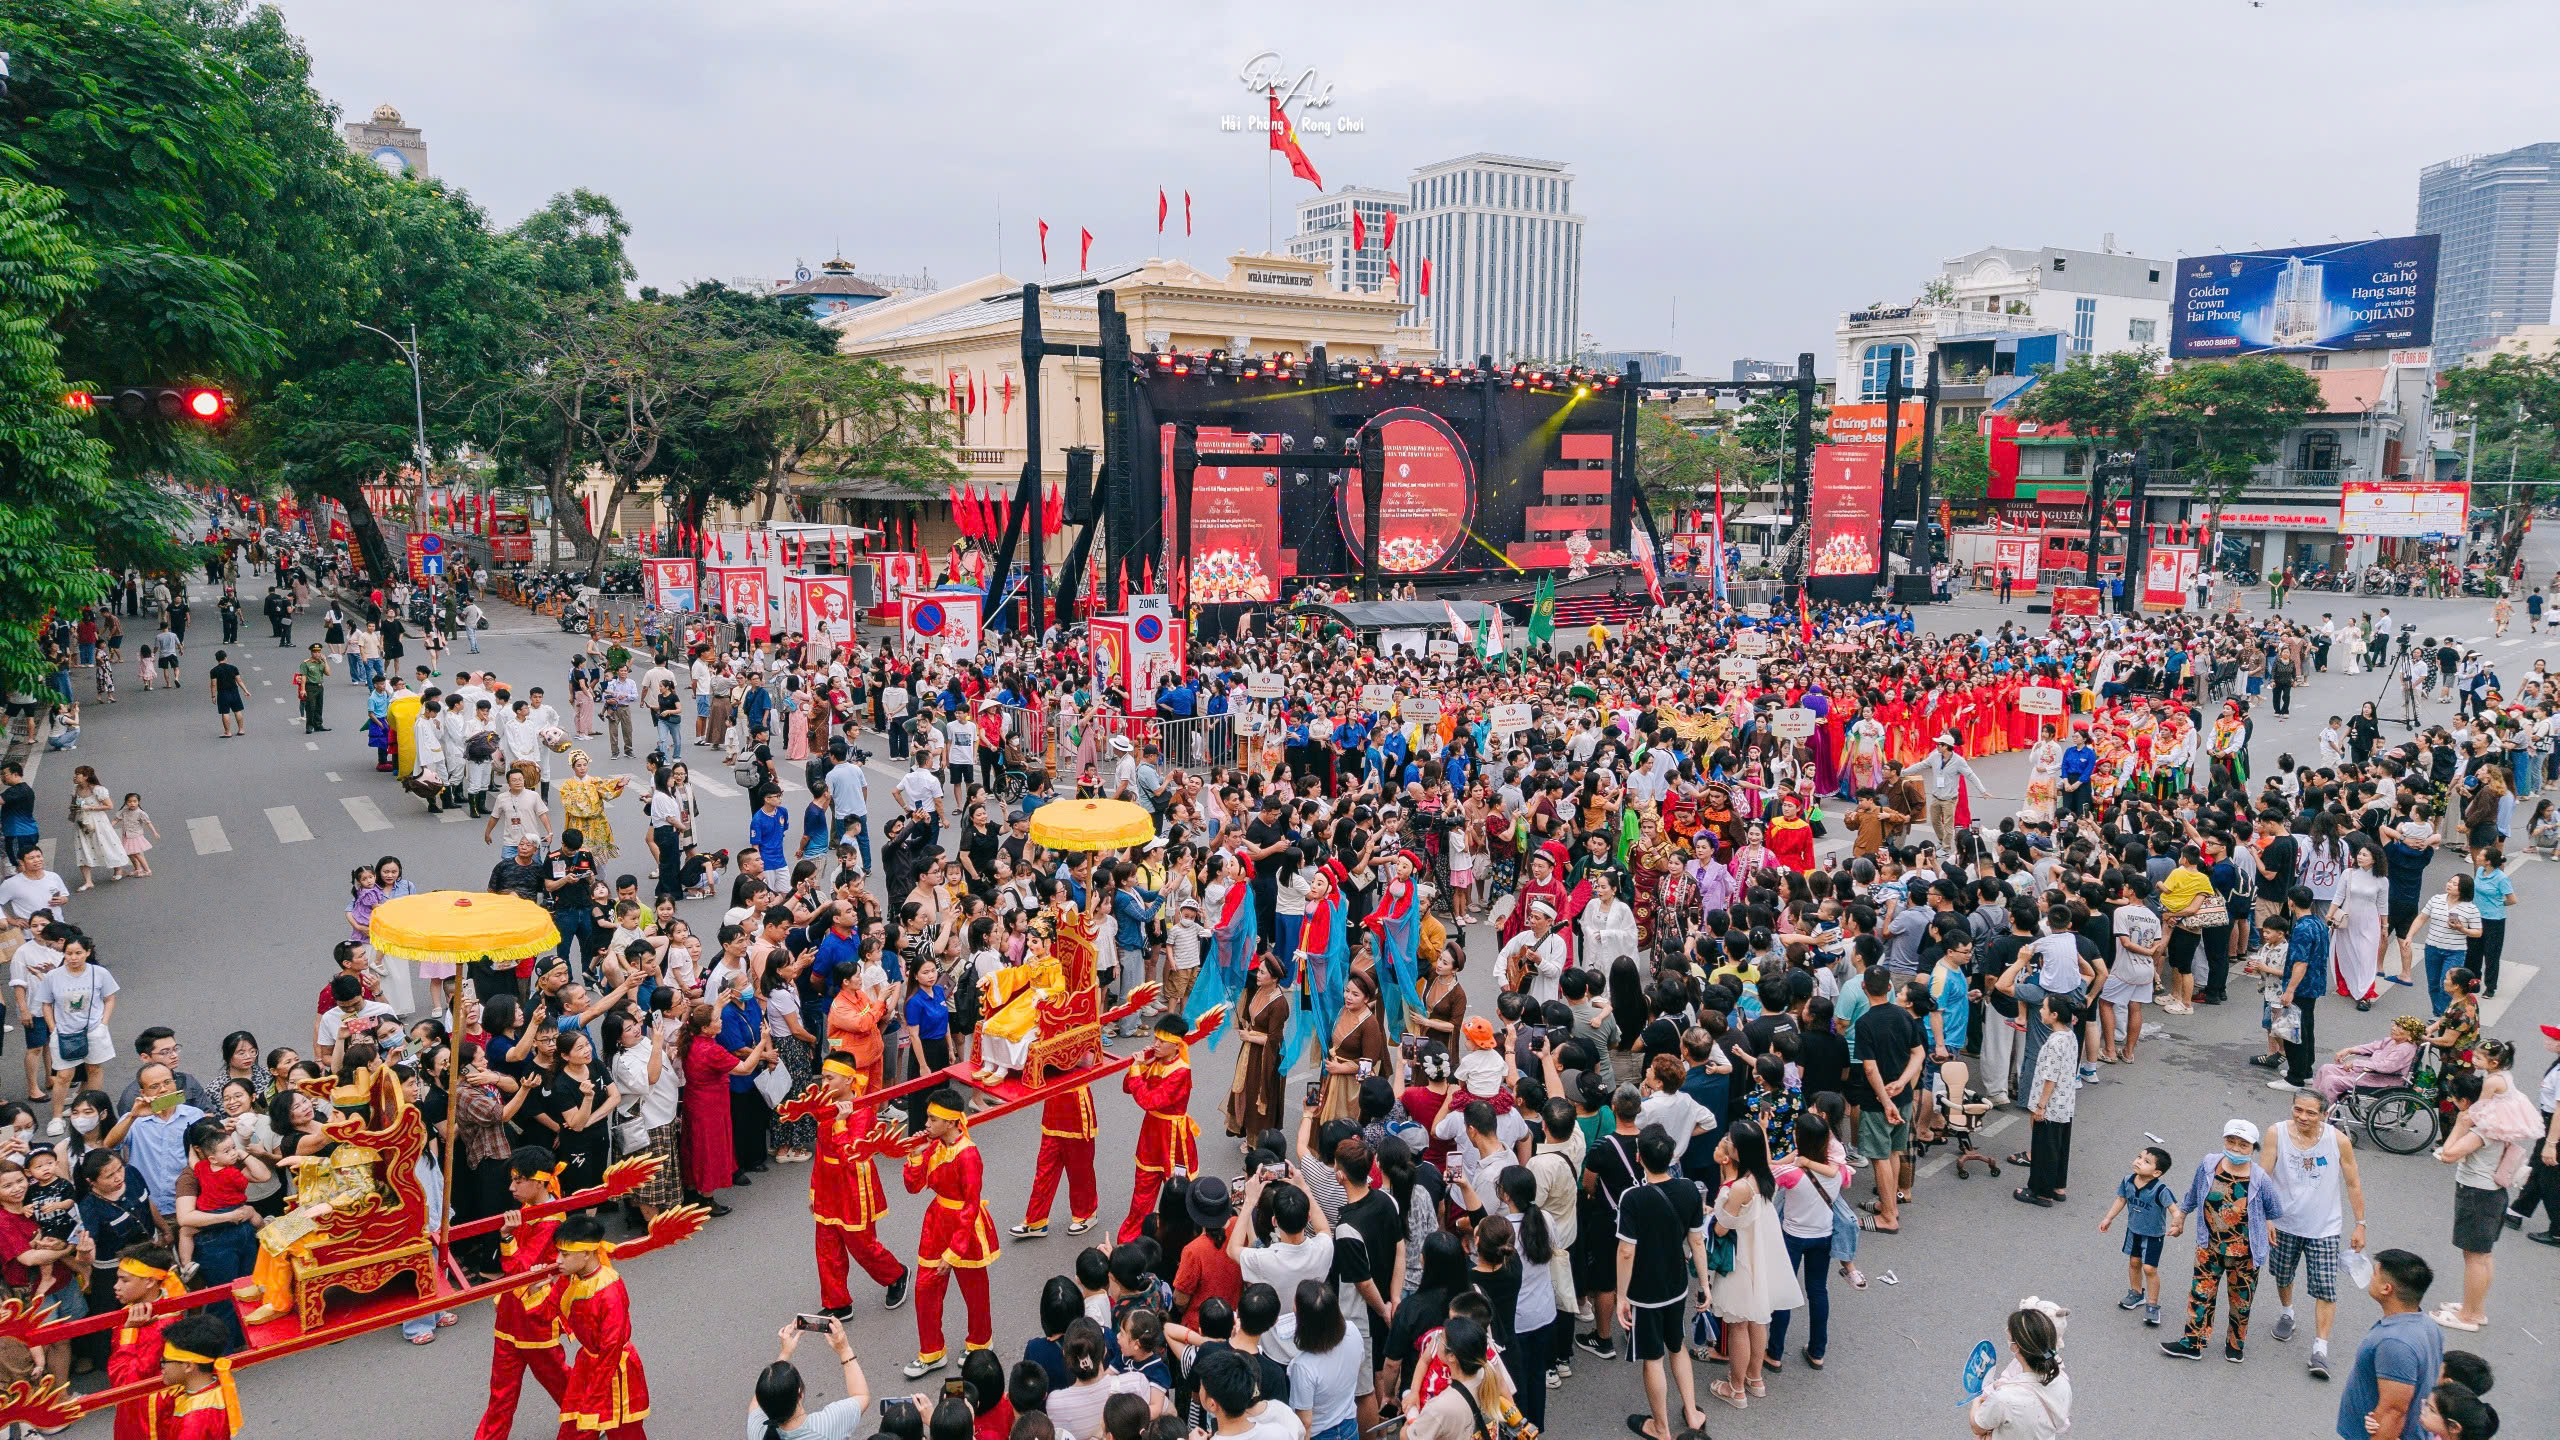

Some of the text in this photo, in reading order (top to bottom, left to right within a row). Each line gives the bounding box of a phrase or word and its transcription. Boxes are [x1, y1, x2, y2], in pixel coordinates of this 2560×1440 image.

[381, 138, 402, 146] LONG
[1248, 271, 1262, 282] NHÀ
[1263, 272, 1276, 283] HÁT
[1277, 273, 1299, 285] THÀNH
[2373, 269, 2417, 284] Căn hộ
[2189, 285, 2229, 298] Golden
[2352, 285, 2416, 300] Hạng sang
[2188, 300, 2224, 310] Crown
[2187, 310, 2241, 321] Hai Phong
[2350, 307, 2414, 323] DOJILAND
[1832, 417, 1906, 430] Chứng Khn
[2006, 510, 2084, 520] TRUNG NGUYÊN
[1139, 599, 1159, 608] ZONE
